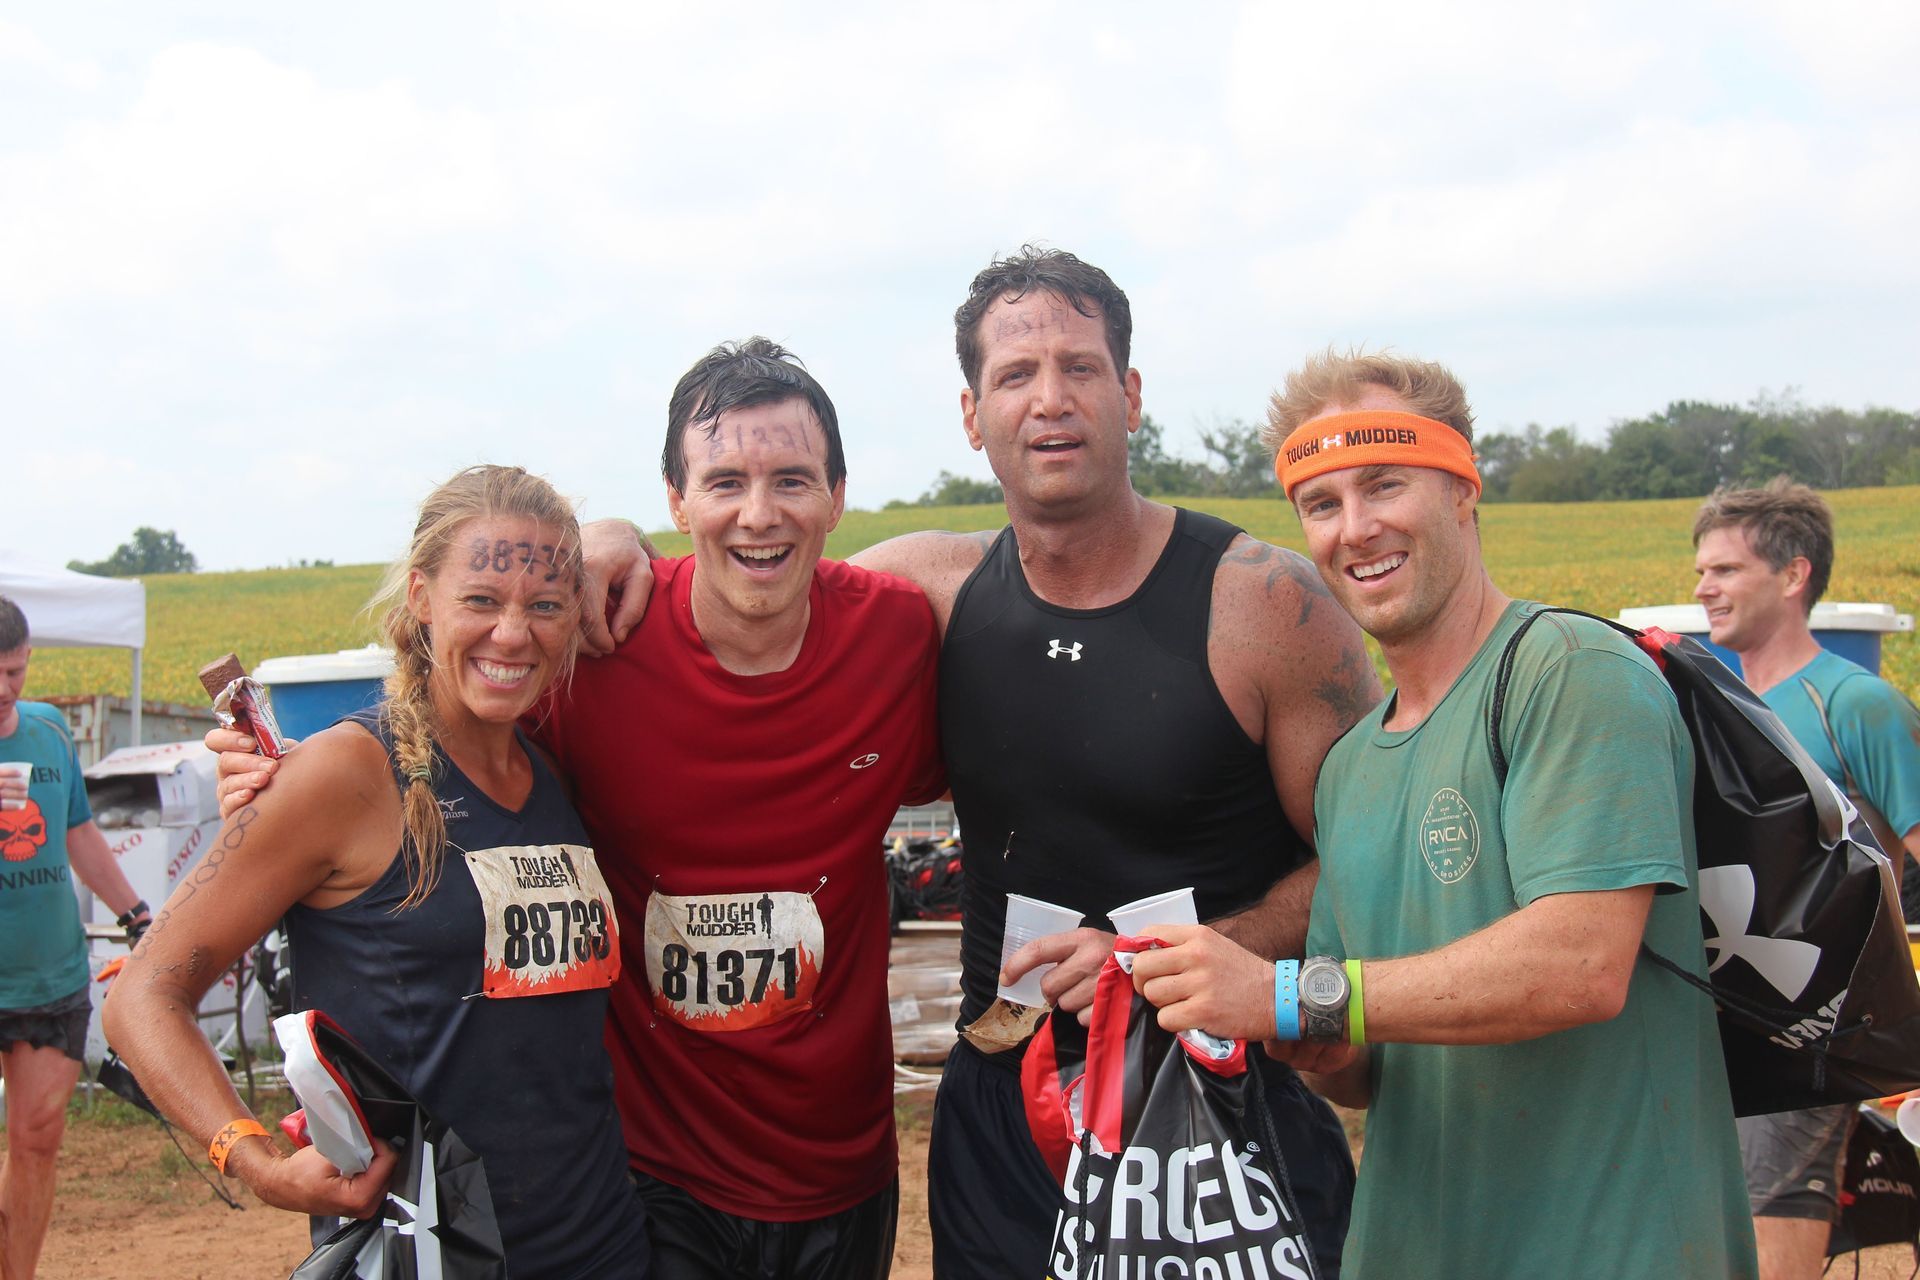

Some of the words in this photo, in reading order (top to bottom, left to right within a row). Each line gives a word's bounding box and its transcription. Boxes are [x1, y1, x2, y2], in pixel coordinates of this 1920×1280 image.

[1286, 438, 1320, 466] TOUGH
[1345, 427, 1417, 448] MUDDER
[1428, 825, 1468, 846] RVCA
[509, 856, 564, 877] TOUGH
[516, 874, 570, 890] MUDDER
[685, 902, 754, 923] TOUGH
[503, 899, 611, 970] 88733
[686, 922, 756, 937] MUDDER
[661, 943, 797, 1006] 81371
